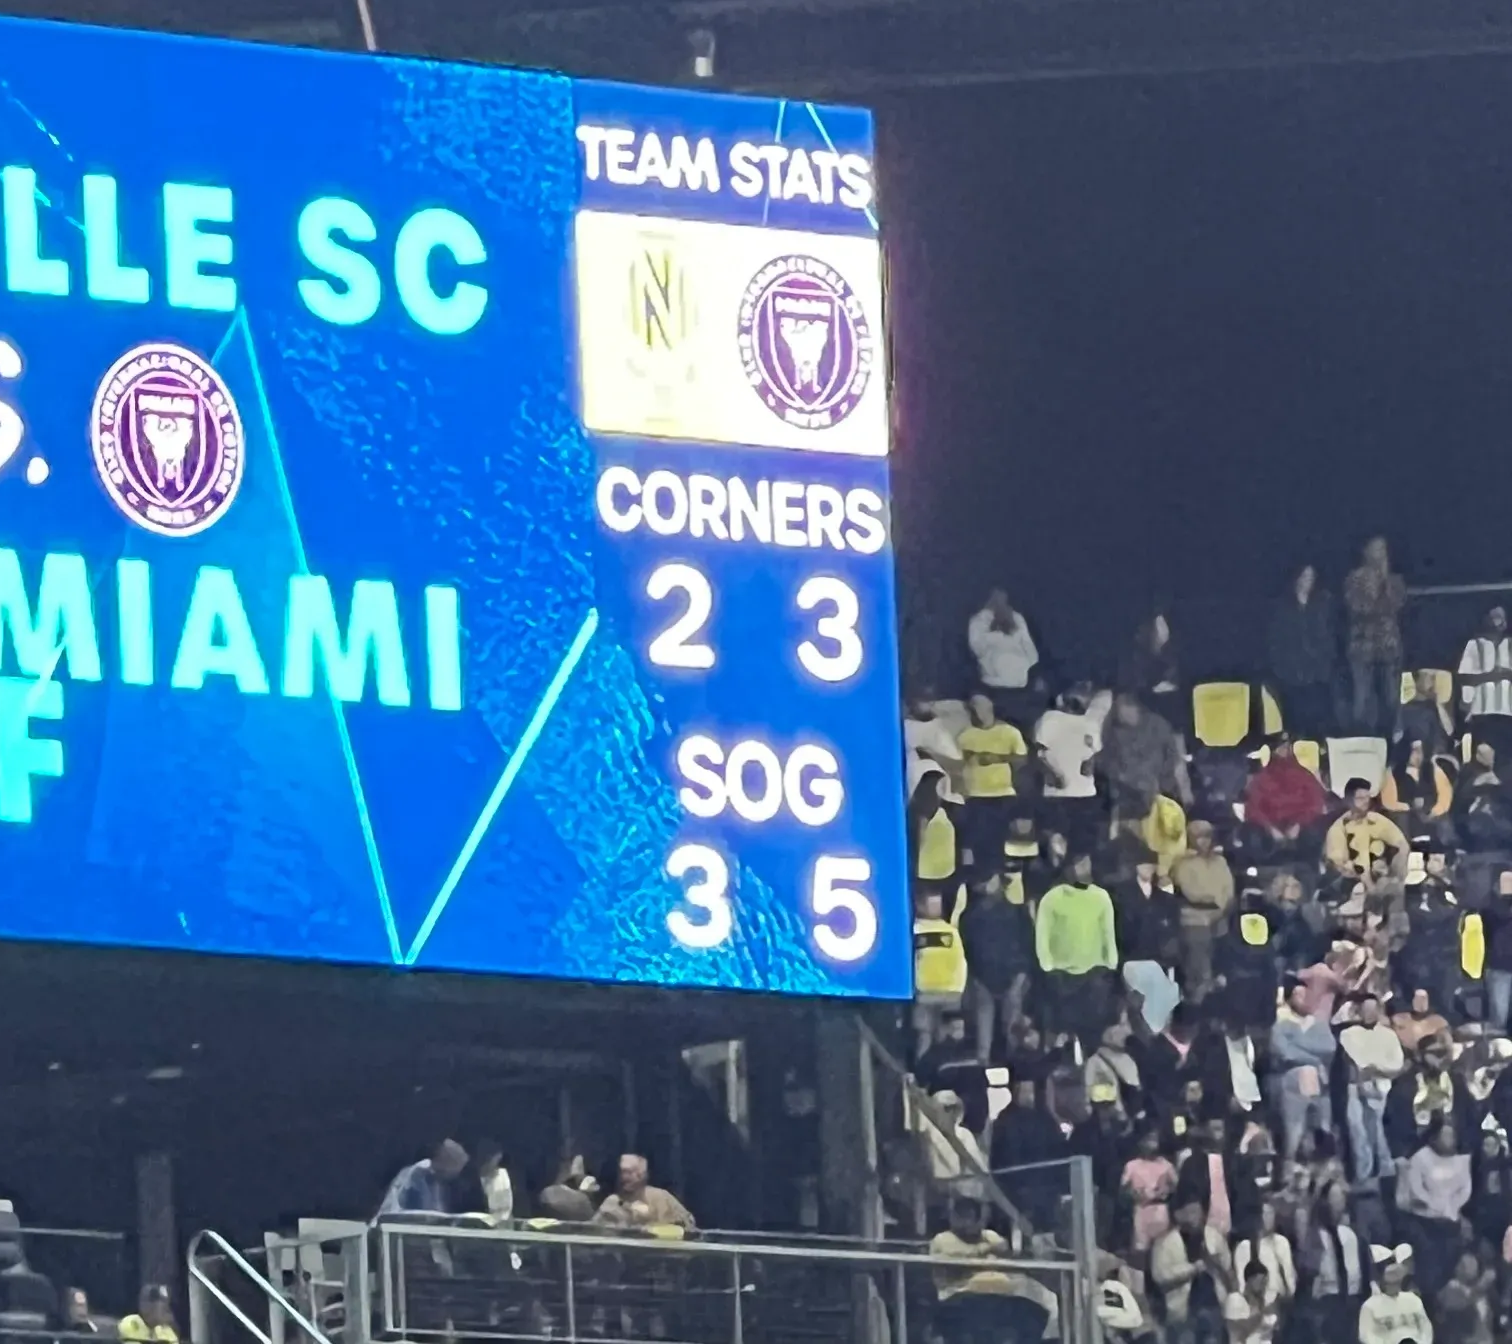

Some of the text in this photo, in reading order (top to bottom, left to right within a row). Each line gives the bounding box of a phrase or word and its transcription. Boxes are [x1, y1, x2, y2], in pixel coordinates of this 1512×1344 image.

[576, 124, 873, 208] TEAM STATS
[298, 196, 488, 335] SC
[596, 465, 887, 555] CORNERS
[646, 563, 716, 668] 2
[796, 576, 863, 682] 3
[677, 734, 844, 826] SOG
[666, 843, 734, 947] 3
[812, 856, 877, 962] 5
